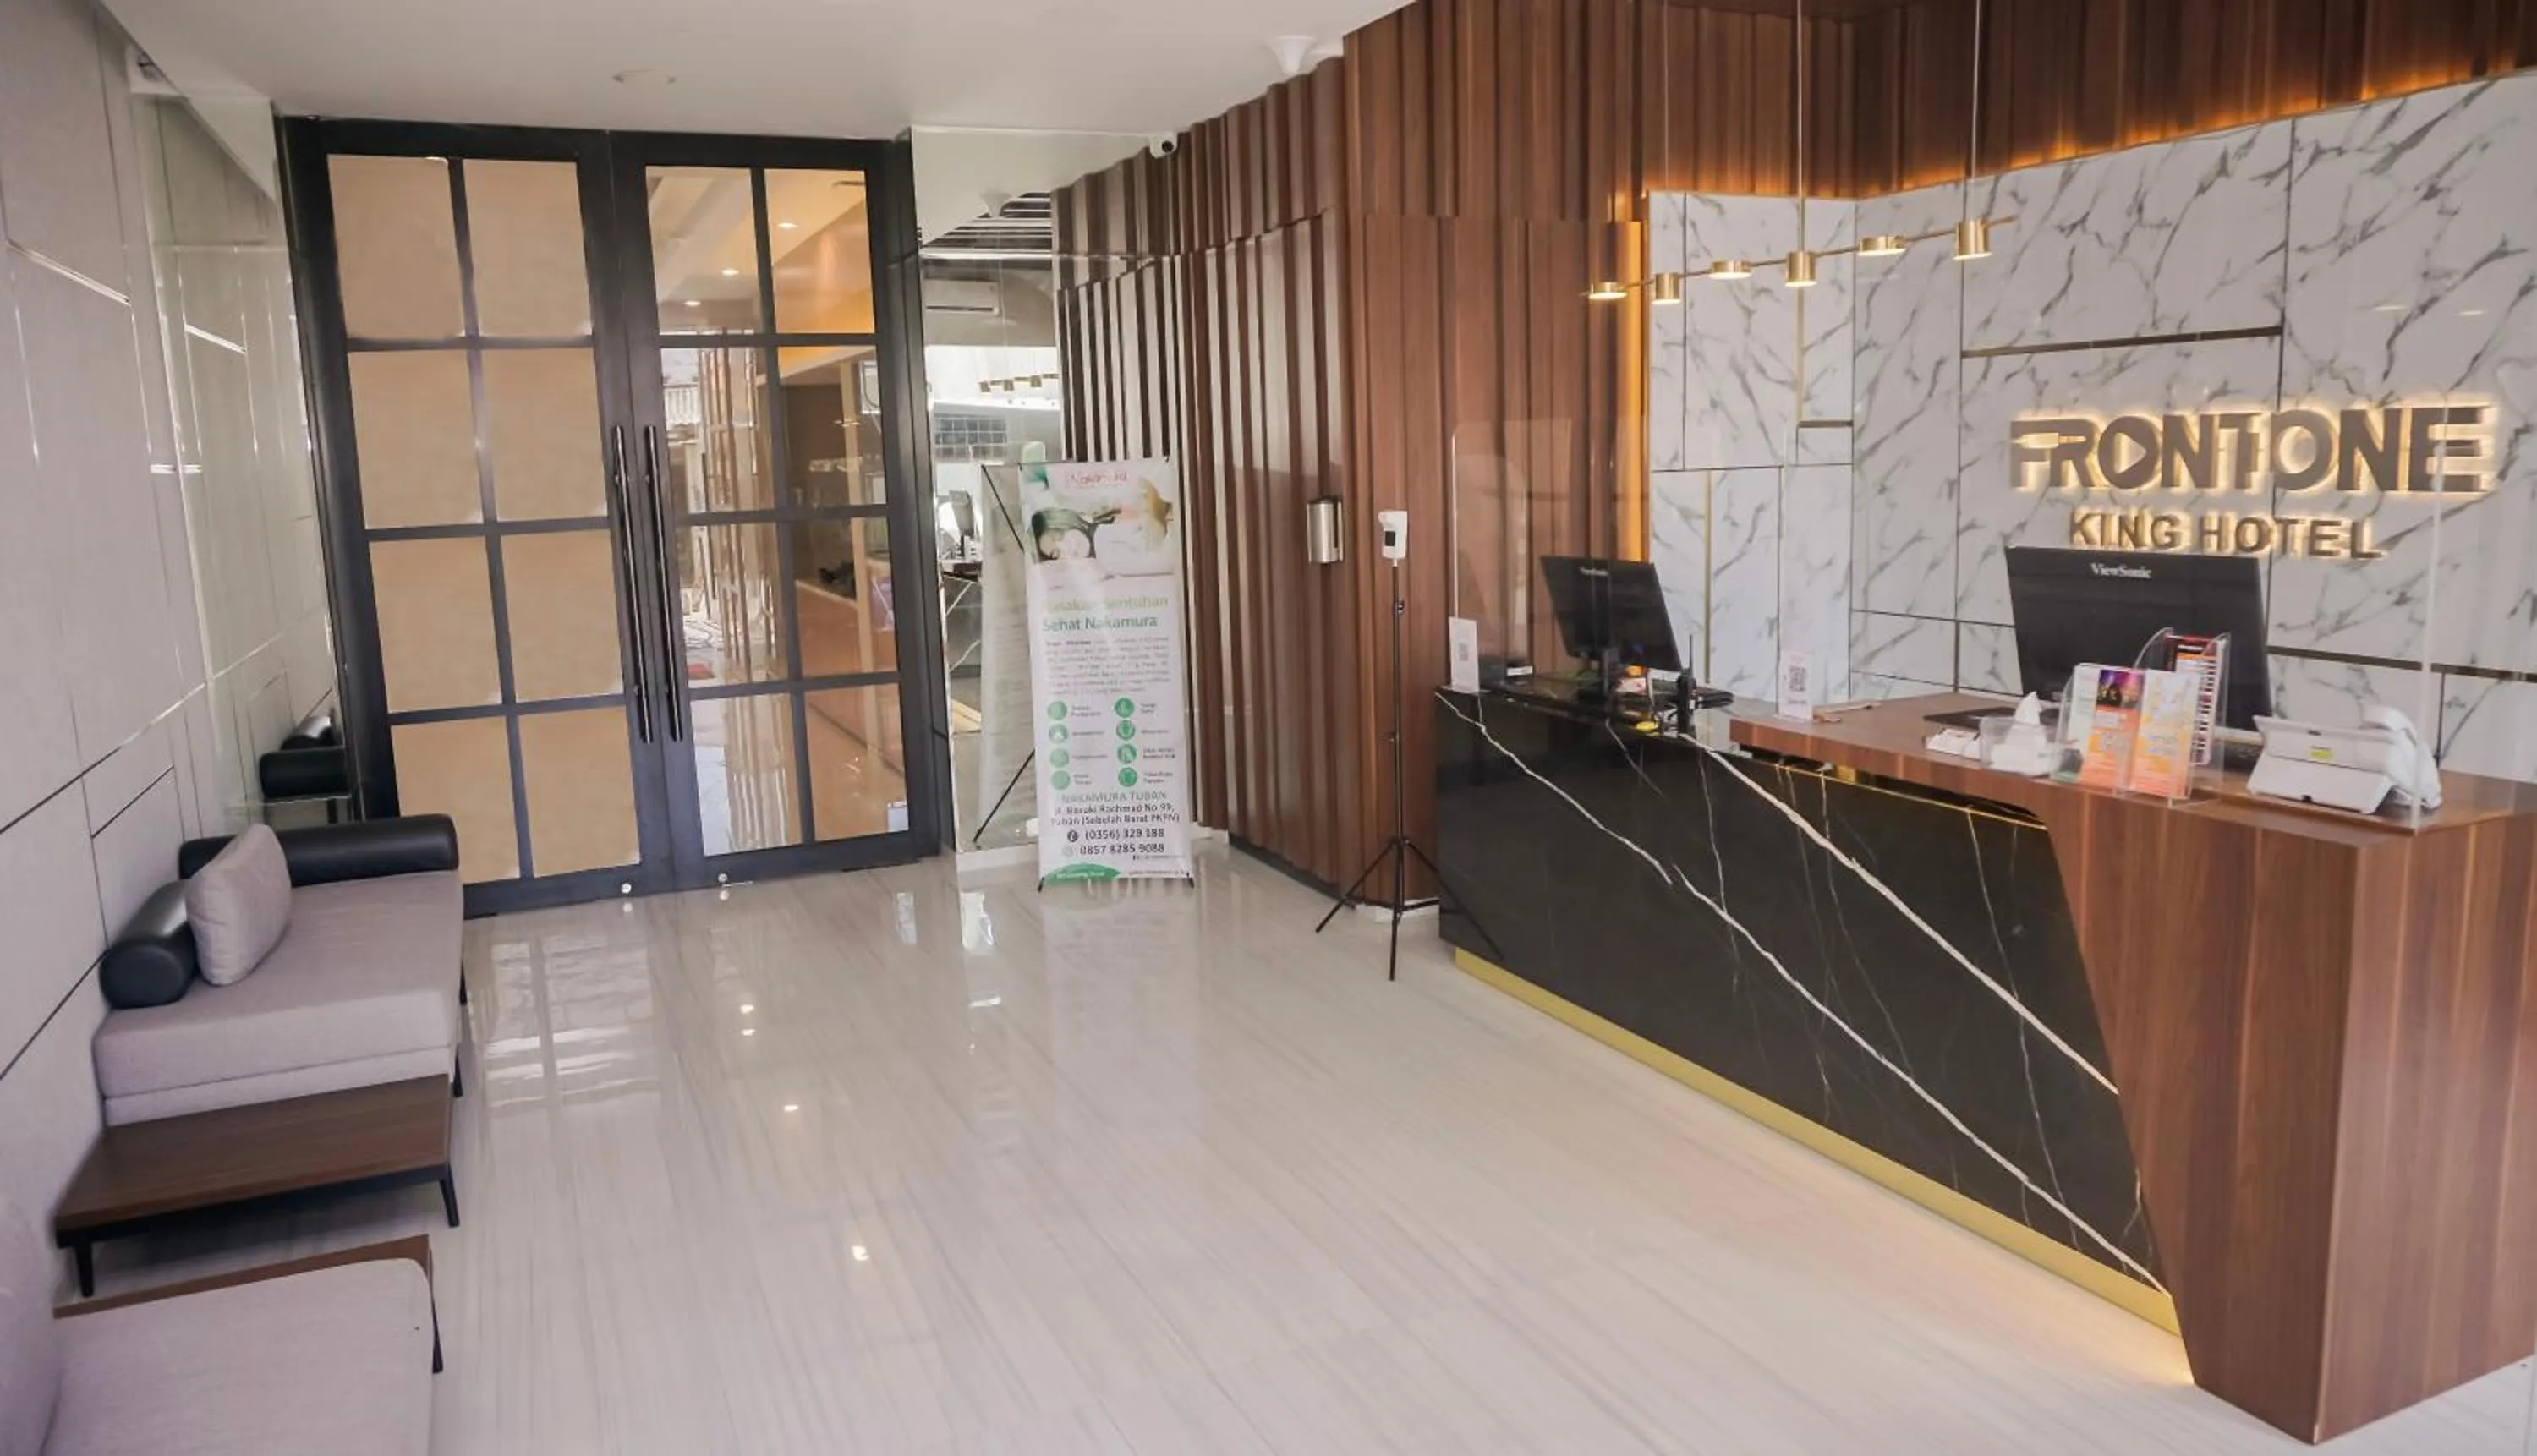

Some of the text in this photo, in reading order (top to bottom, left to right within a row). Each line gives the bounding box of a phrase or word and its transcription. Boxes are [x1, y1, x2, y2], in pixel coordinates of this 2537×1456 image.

[2010, 406, 2490, 493] FRONTONE
[2069, 512, 2384, 560] KING HOTEL
[2090, 562, 2153, 579] ViewSonic
[1042, 618, 1082, 632] Sehat
[1085, 828, 1164, 841] (0356) 329 188
[1079, 845, 1107, 855] 0857
